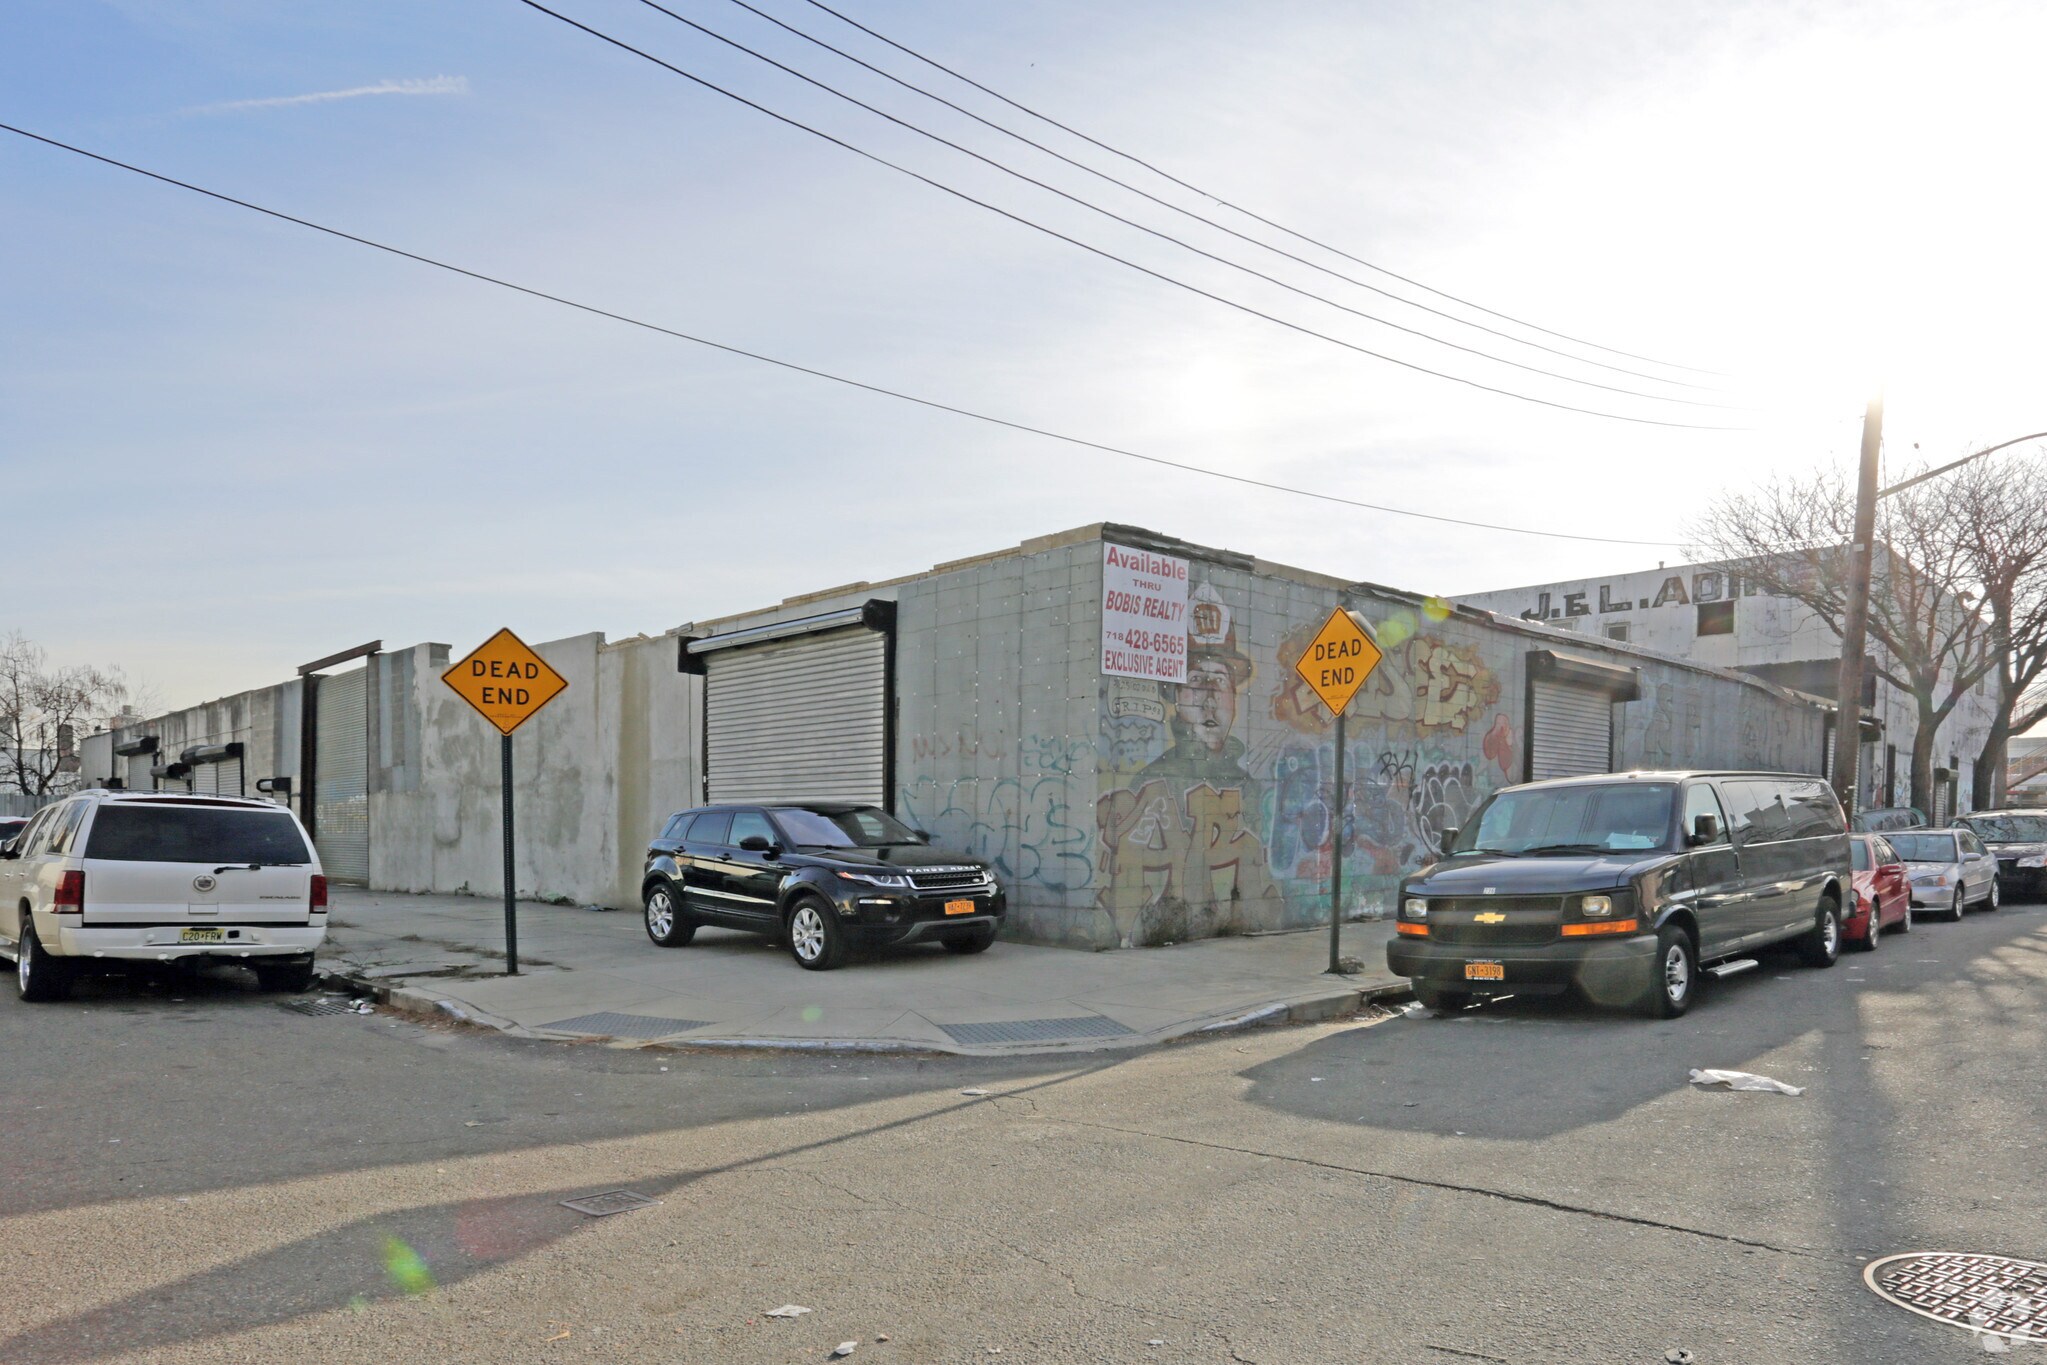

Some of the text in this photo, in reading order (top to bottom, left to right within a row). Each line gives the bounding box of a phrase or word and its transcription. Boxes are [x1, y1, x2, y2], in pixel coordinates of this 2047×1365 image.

[1106, 546, 1187, 580] Available
[1132, 578, 1162, 591] THRU
[1105, 590, 1186, 622] BOBIS REALTY
[1106, 628, 1184, 655] 718 428-6565
[1315, 638, 1362, 661] DEAD
[472, 660, 539, 679] DEAD
[1105, 650, 1184, 678] EXCLUSIVE AGENT
[1321, 667, 1355, 687] END
[482, 687, 530, 705] END
